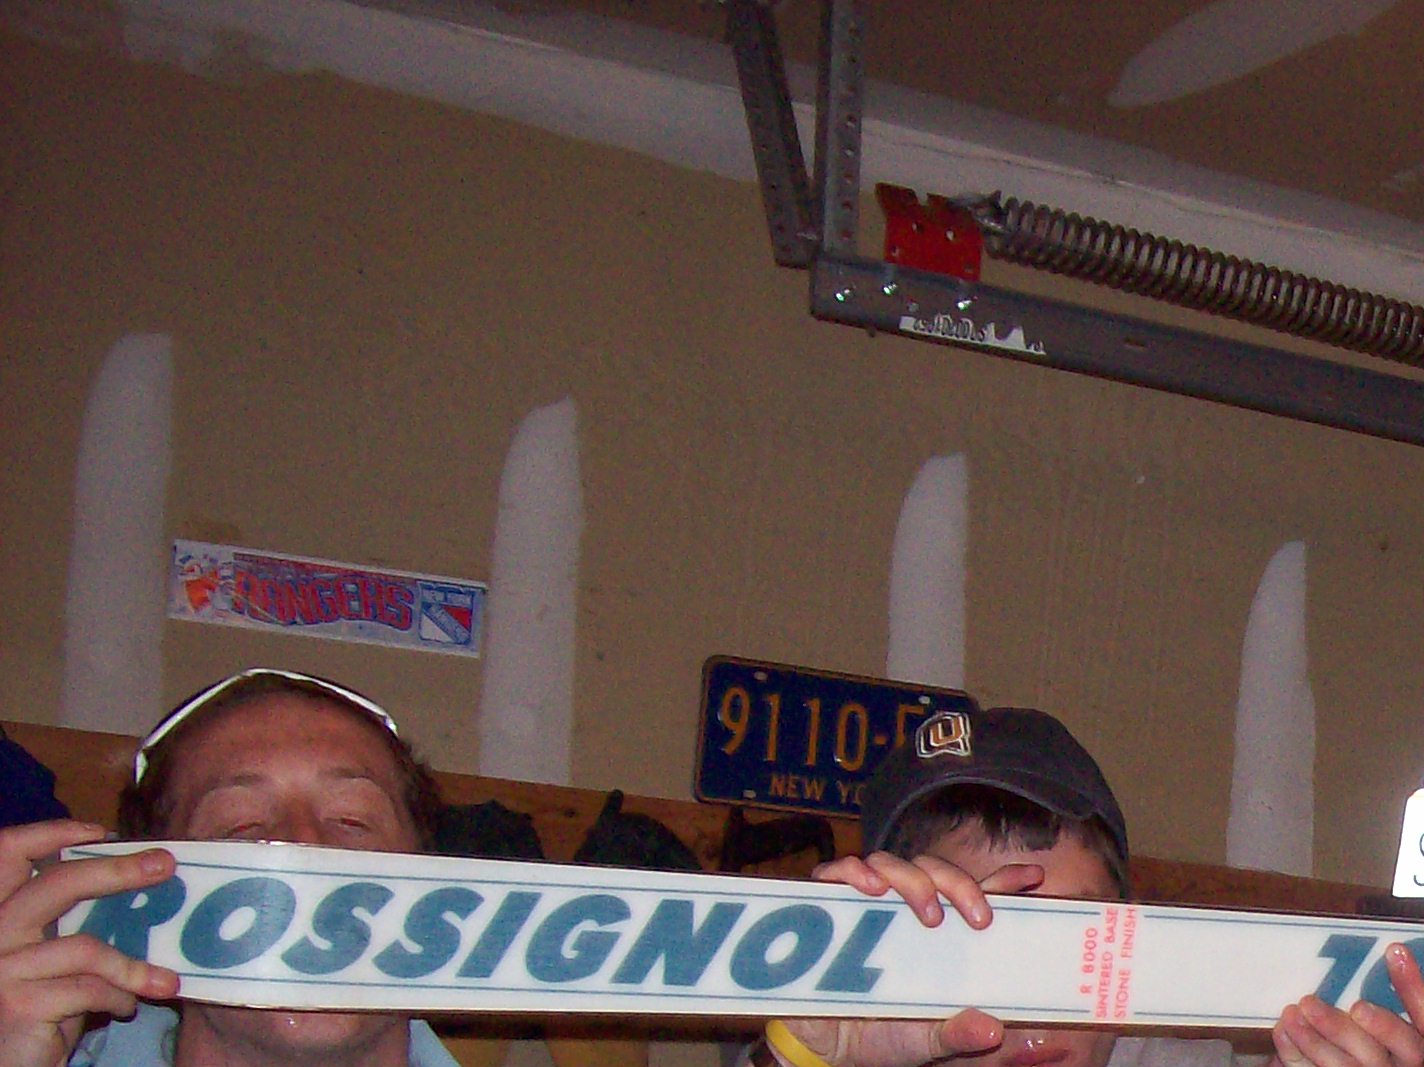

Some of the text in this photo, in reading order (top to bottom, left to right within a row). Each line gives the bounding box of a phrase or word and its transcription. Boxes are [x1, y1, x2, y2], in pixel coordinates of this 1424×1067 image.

[230, 568, 415, 632] RANGERS
[769, 773, 827, 801] NEW
[78, 874, 897, 993] ROSSIGNOL
[1095, 907, 1118, 1019] SINTERED BASE
[1114, 907, 1136, 1019] STONE FINISH
[1079, 984, 1092, 994] R
